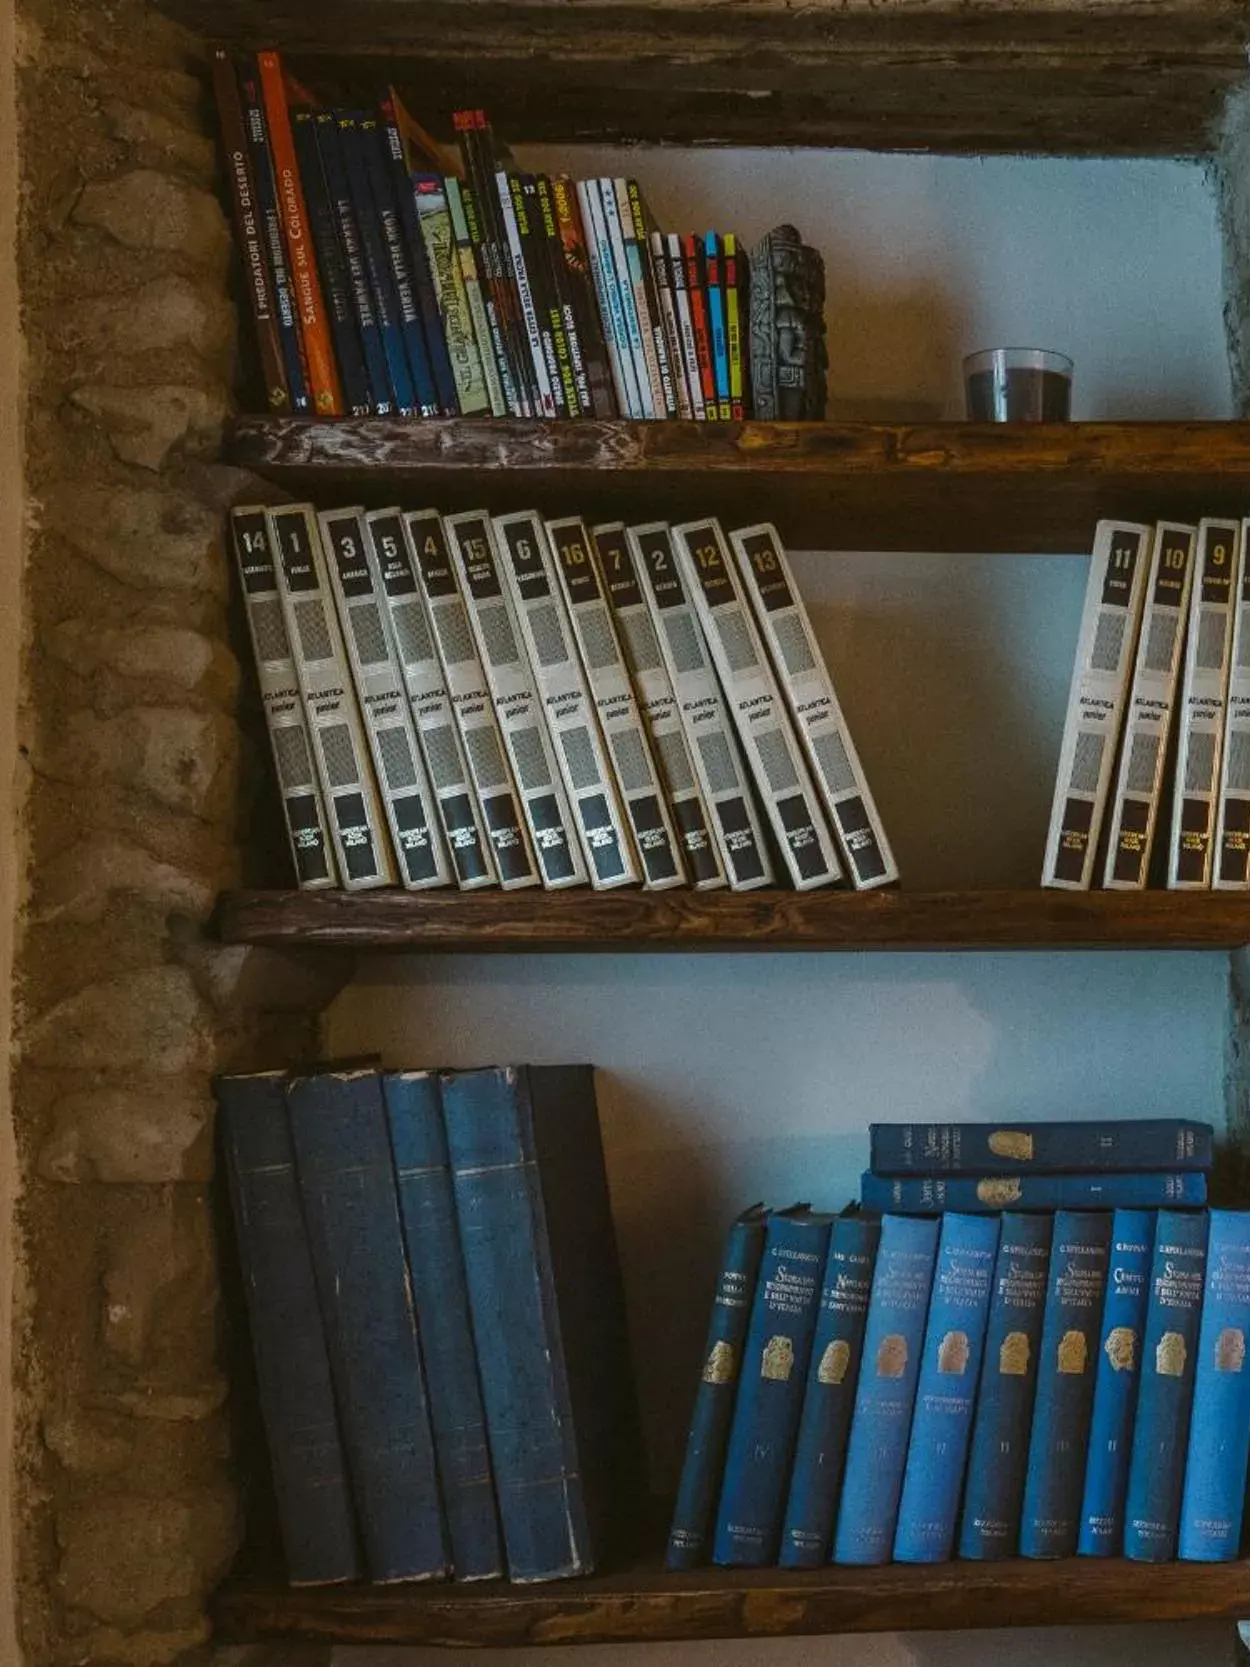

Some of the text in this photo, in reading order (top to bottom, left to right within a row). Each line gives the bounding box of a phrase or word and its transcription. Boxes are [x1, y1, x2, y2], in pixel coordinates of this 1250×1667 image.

[232, 150, 251, 207] DESERTO
[244, 210, 256, 235] DEL
[282, 168, 317, 325] SANGUE SUL COLORADO
[246, 239, 268, 311] PREDATORI
[560, 303, 575, 330] BLOCH
[542, 330, 564, 405] SPAZIO PROFONDO
[548, 306, 579, 417] DYLAN DOG COLOR FEST
[579, 390, 590, 407] MAI
[660, 375, 677, 411] RITRATTO
[242, 531, 266, 553] 14
[290, 532, 300, 553] 1
[340, 536, 356, 559] 3
[381, 536, 398, 558] 5
[424, 536, 438, 557] 4
[462, 538, 487, 561] 15
[515, 539, 531, 561] 6
[561, 542, 586, 566] 16
[608, 549, 621, 571] 7
[651, 549, 668, 571] 2
[695, 545, 720, 569] 12
[754, 550, 776, 573] 13
[1114, 549, 1131, 570] 11
[1164, 548, 1185, 569] 10
[1212, 543, 1226, 565] 9
[263, 689, 298, 700] ATLANTICA
[307, 689, 343, 701] ATLANTICA
[364, 691, 401, 703] ATLANTICA
[410, 689, 446, 702] ATLANTICA
[450, 690, 488, 703] ATLANTICA
[496, 691, 532, 704] ATLANTICA
[547, 690, 581, 704] ATLANTICA
[599, 693, 632, 706] ATLANTICA
[683, 697, 717, 710] ATLANTICA
[738, 694, 773, 710] ATLANTICA
[797, 696, 831, 713] ATLANTICA
[1080, 698, 1114, 709] ATLANTICA
[1136, 698, 1169, 709] ATLANTICA
[1189, 697, 1222, 707] ATLANTICA
